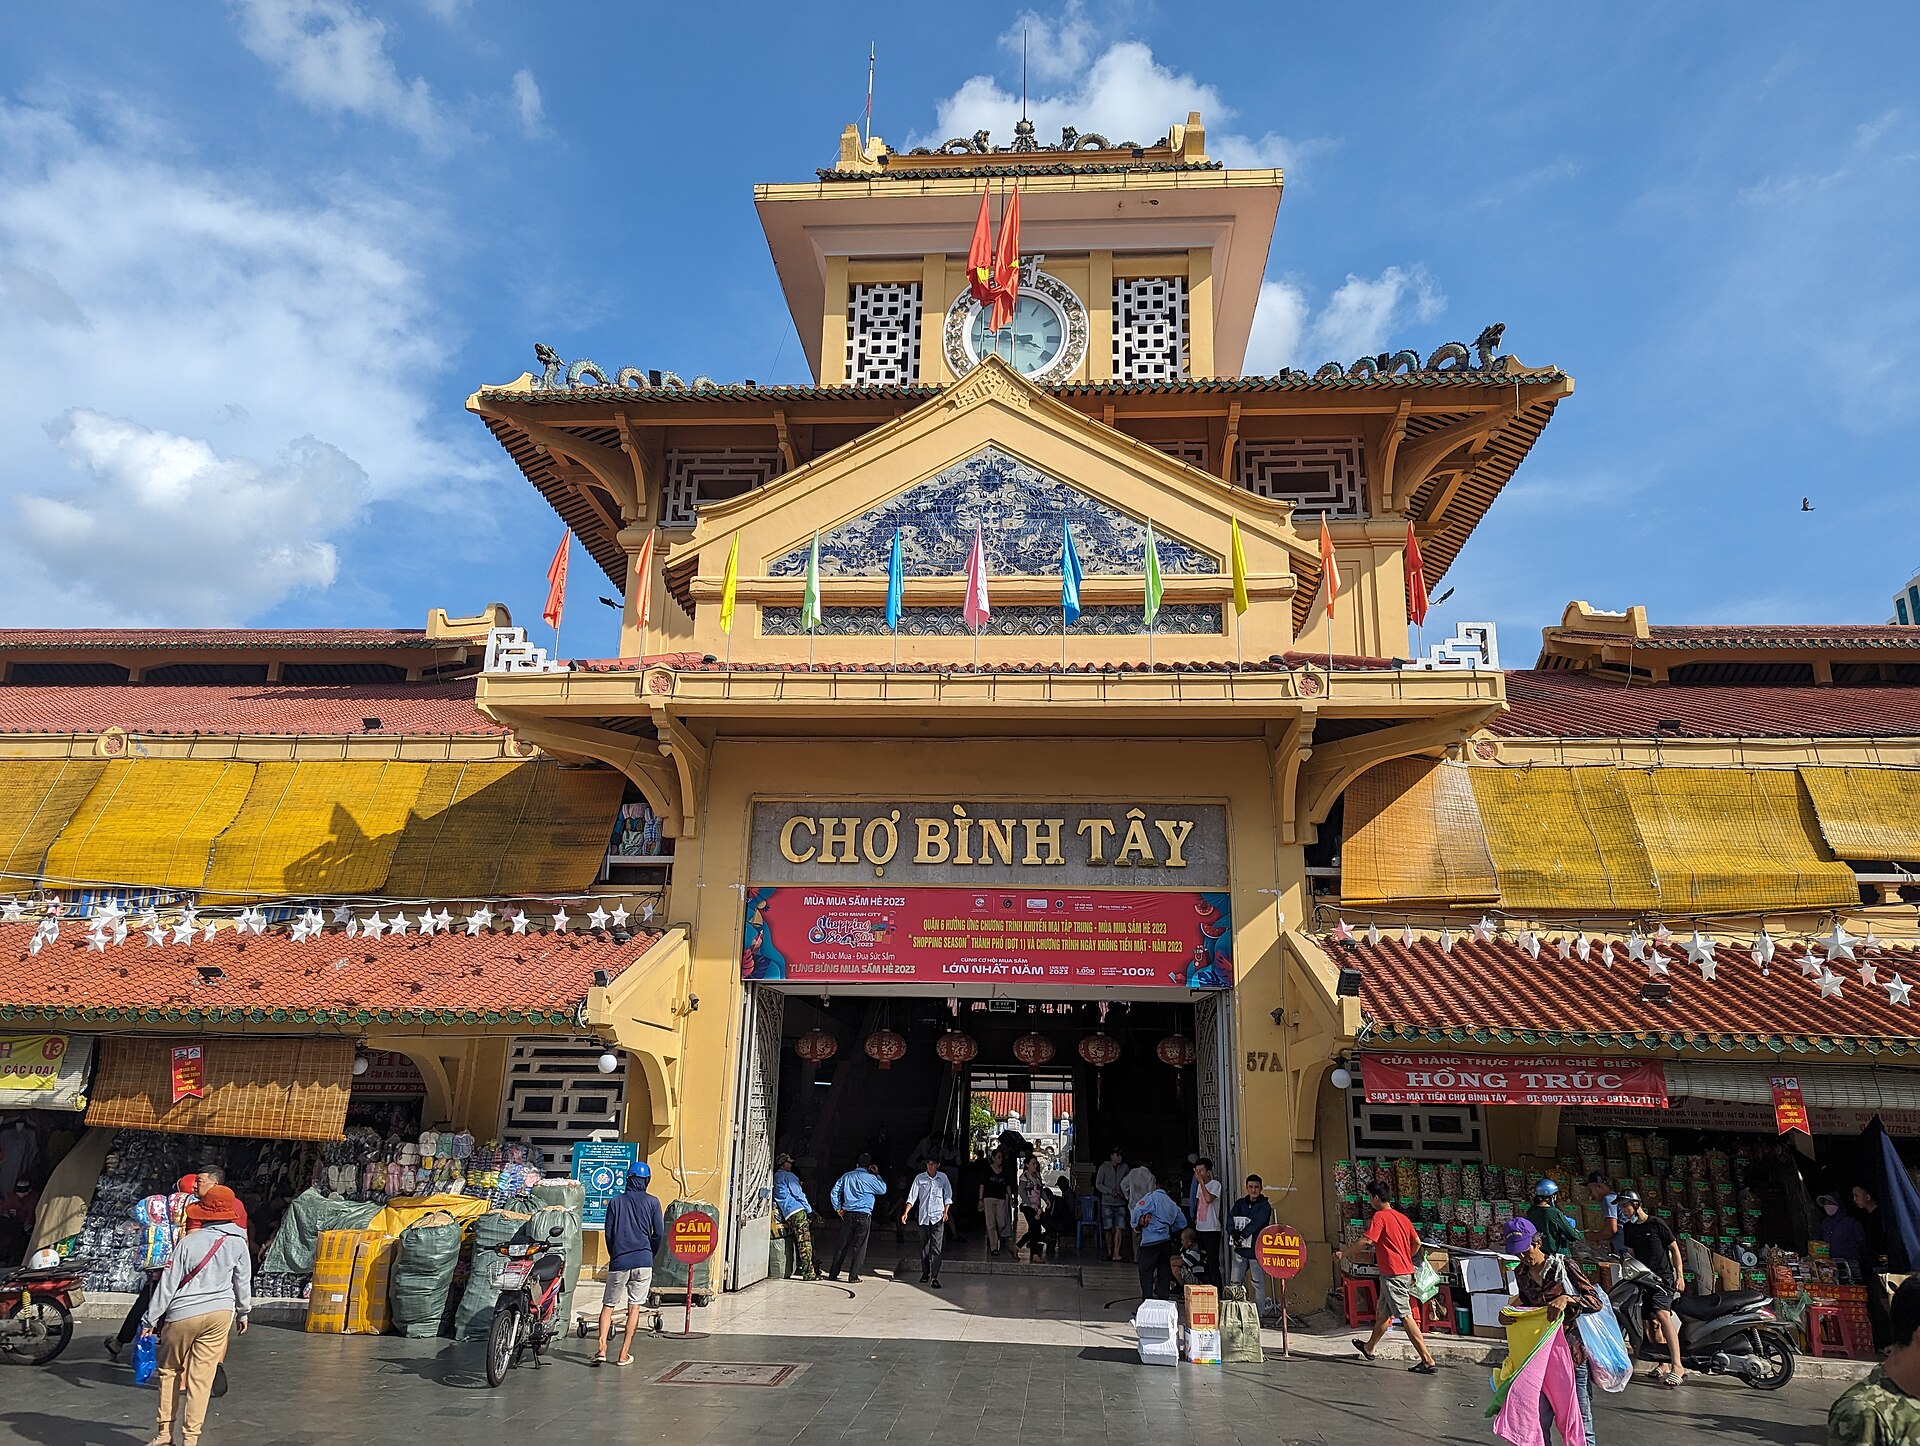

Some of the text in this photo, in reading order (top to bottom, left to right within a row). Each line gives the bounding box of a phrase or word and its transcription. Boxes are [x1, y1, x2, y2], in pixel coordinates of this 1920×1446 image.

[779, 804, 1195, 876] CHỢ BÌNH TÂY
[826, 896, 847, 906] MUA
[870, 895, 882, 906] HÈ
[883, 897, 905, 907] 2023
[923, 917, 940, 932] QUẬN
[940, 919, 945, 931] 6
[945, 916, 966, 931] HƯỞNG
[980, 919, 1004, 932] CHƯƠNG
[1005, 918, 1023, 932] TRÌNH
[1023, 918, 1047, 932] KHUYẾN
[1048, 920, 1060, 934] MẠI
[1060, 919, 1073, 935] TẬP
[1073, 921, 1093, 933] TRUNG
[1098, 920, 1112, 933] MÙA
[1113, 922, 1127, 933] MUA
[1142, 920, 1151, 934] HÈ
[1151, 922, 1167, 934] 2023
[971, 935, 991, 949] THÀNH
[992, 934, 1004, 950] PHỐ
[1027, 936, 1036, 950] VÀ
[1036, 938, 1061, 951] CHƯƠNG
[1061, 937, 1080, 951] TRÌNH
[1080, 937, 1097, 951] NGÀY
[1097, 938, 1118, 951] KHÔNG
[1133, 938, 1147, 954] MẶT
[1152, 938, 1167, 952] NĂM
[1167, 941, 1183, 953] 2023
[838, 952, 852, 960] Mua
[840, 964, 860, 974] MUA
[881, 962, 894, 974] HÈ
[894, 965, 916, 974] 2023
[942, 960, 1044, 975] LỚN NHẤT NĂM
[1122, 967, 1155, 977] 100%
[45, 1042, 63, 1056] 13
[1246, 1052, 1284, 1072] 57A
[1380, 1055, 1413, 1065] CỬA
[1418, 1055, 1461, 1065] HÀNG
[1465, 1058, 1508, 1067] THỰC
[1564, 1057, 1599, 1067] CHẾ
[1603, 1058, 1643, 1068] BIẾN
[4, 1063, 55, 1076] CÁC LOẠI
[1405, 1066, 1623, 1089] HỒNG TRÚC
[1390, 1092, 1401, 1100] 15
[1406, 1091, 1424, 1102] MẶT
[1448, 1092, 1466, 1103] CHỢ
[1468, 1092, 1489, 1101] BÌNH
[1490, 1093, 1507, 1102] TÂY
[676, 1219, 711, 1233] CẤM
[1262, 1231, 1300, 1247] CẤM
[675, 1242, 711, 1255] XE VÀO CHỢ
[1262, 1255, 1300, 1269] XE VÀO CHỢ
